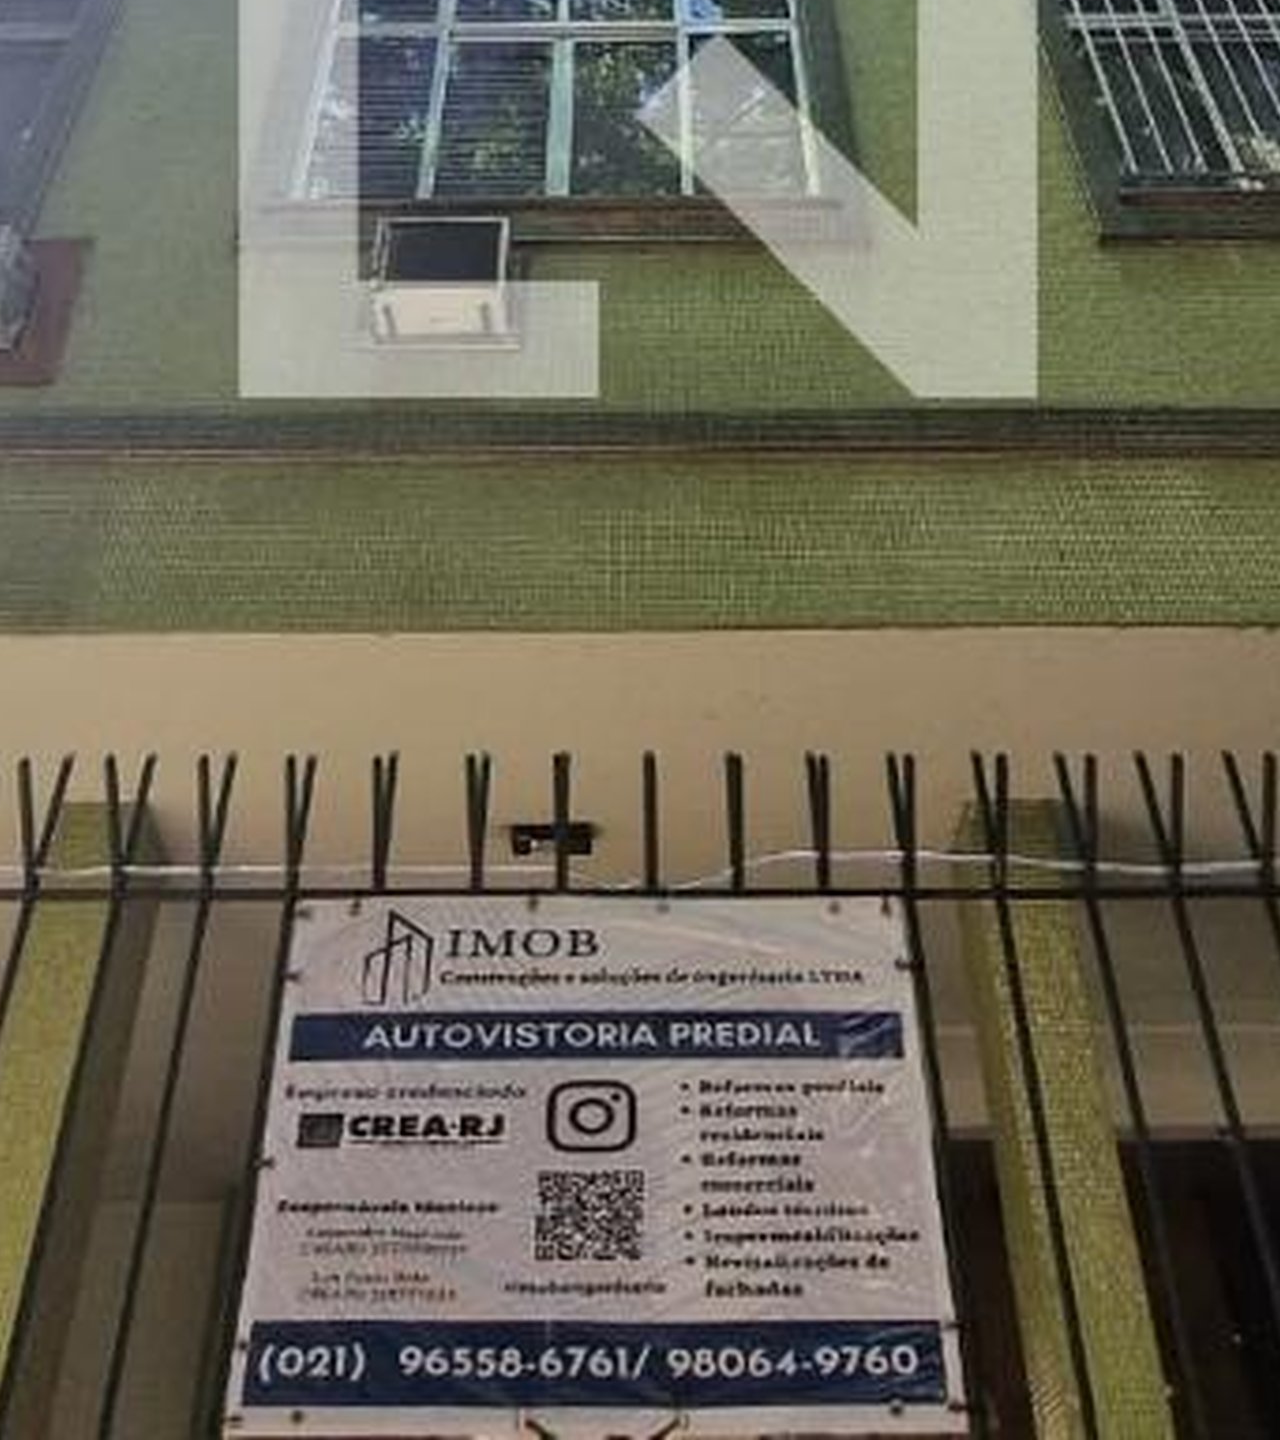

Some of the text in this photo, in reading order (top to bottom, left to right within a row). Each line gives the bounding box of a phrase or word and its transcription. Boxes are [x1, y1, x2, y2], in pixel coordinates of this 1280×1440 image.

[447, 928, 599, 958] IMOB
[363, 1021, 821, 1049] AUTOVISTORIA PREDIAL
[259, 1341, 366, 1382] (021)
[669, 1344, 920, 1378] 98064-9760
